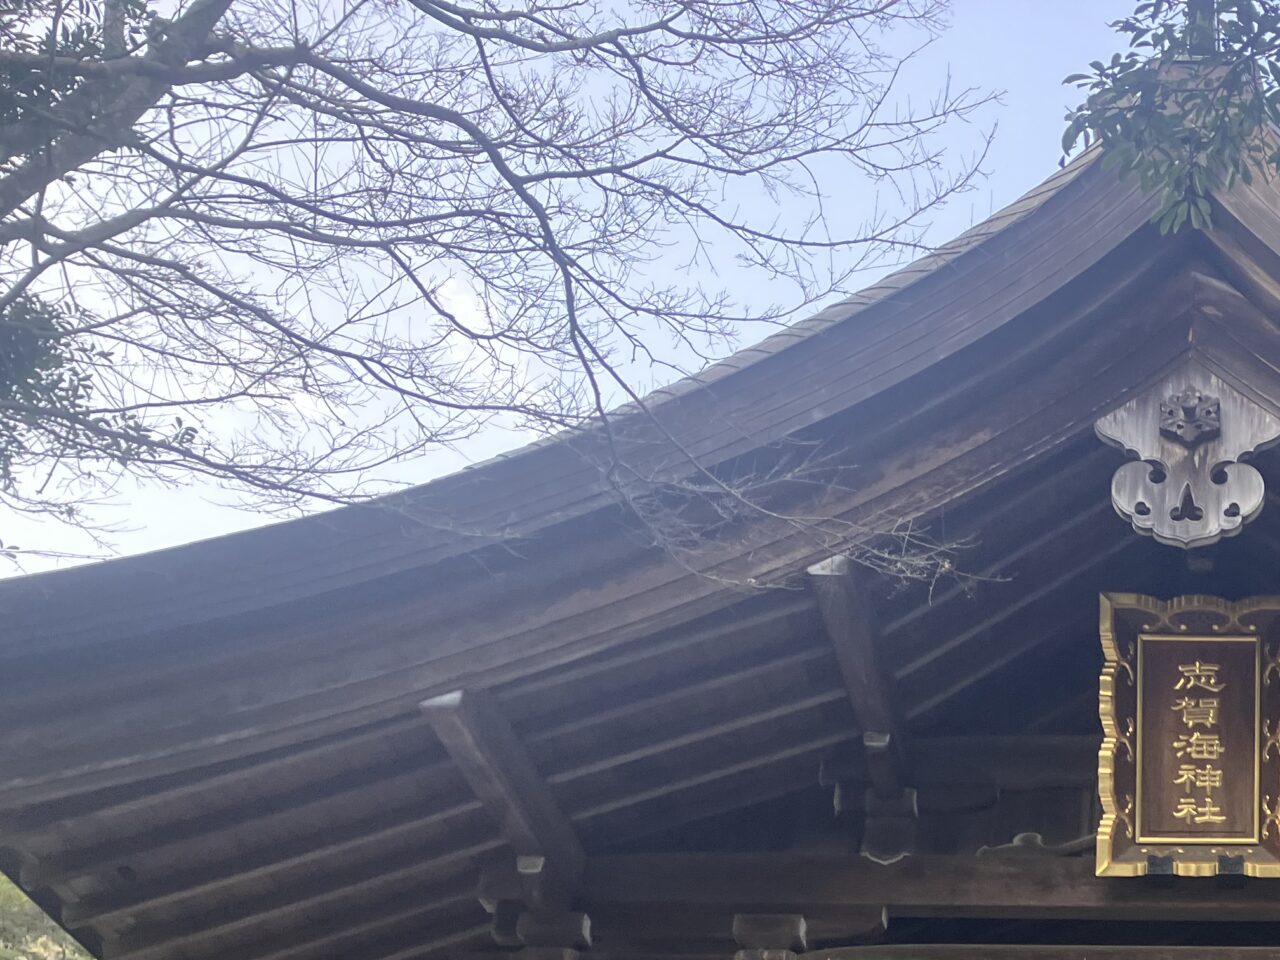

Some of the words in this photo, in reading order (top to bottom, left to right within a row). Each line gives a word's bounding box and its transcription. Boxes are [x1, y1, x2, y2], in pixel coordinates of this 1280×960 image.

[1171, 660, 1226, 824] 志賀海神社
